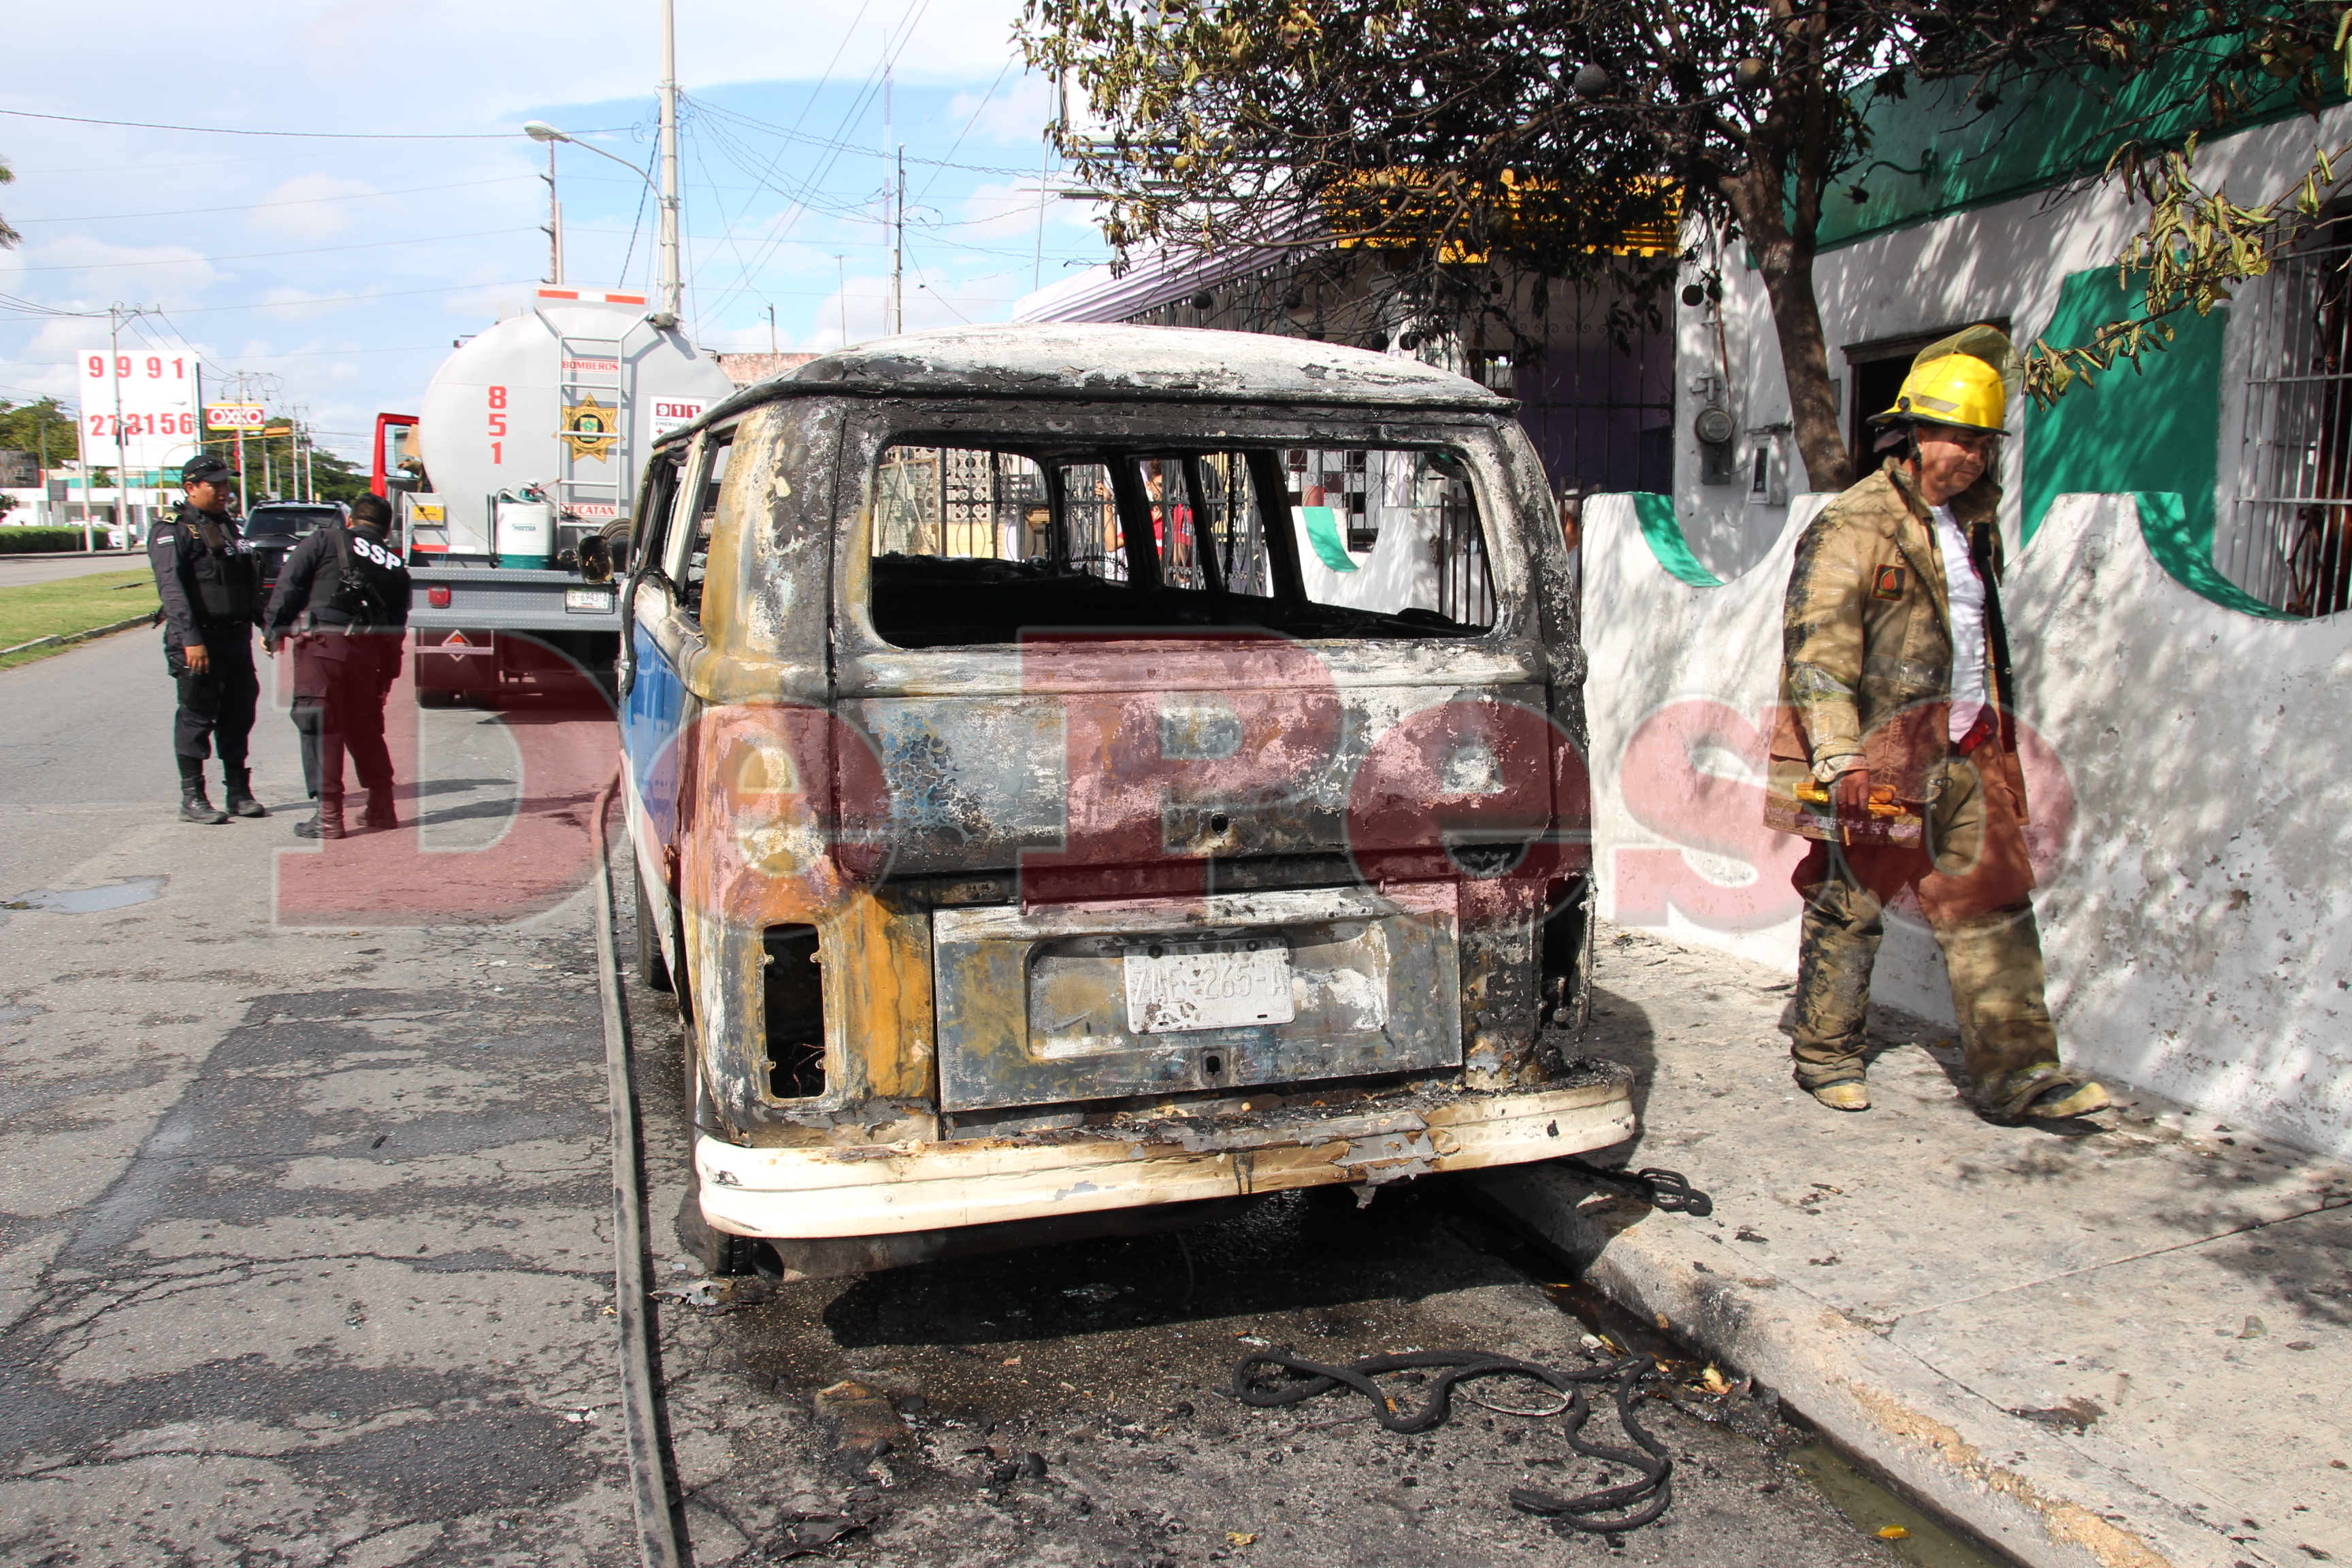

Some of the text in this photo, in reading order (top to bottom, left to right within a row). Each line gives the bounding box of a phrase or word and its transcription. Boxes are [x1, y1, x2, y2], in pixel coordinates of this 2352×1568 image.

[562, 361, 618, 371] BOMBEROS
[209, 409, 263, 424] OXXO
[657, 404, 698, 417] 911
[90, 412, 193, 436] 273156
[564, 506, 615, 515] YUCATAN
[353, 536, 402, 570] SSP
